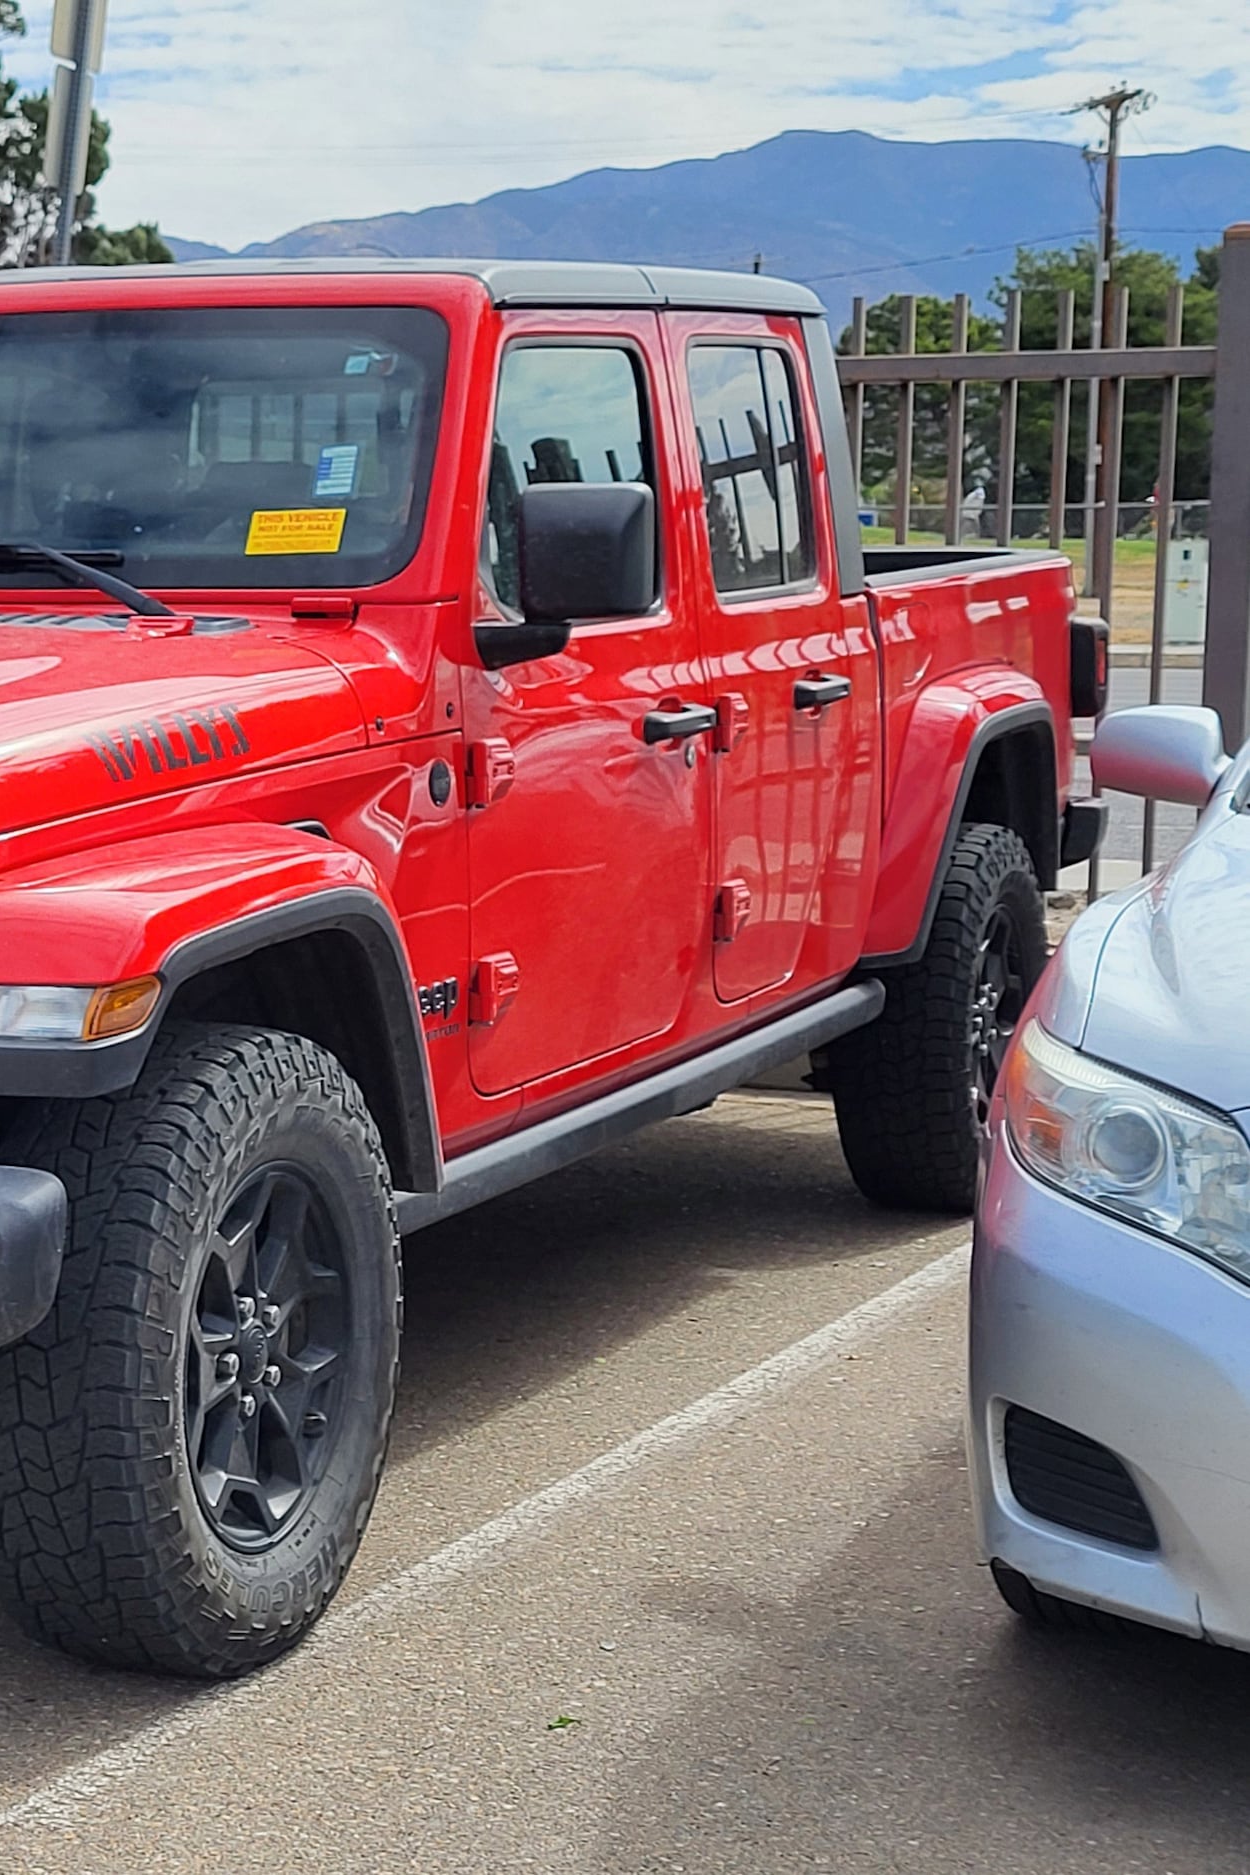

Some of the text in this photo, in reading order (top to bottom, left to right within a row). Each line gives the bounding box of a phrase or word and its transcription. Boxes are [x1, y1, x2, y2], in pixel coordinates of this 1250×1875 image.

[81, 702, 250, 782] WILLYS
[418, 976, 458, 1020] eep
[203, 1532, 338, 1613] HERCULES
